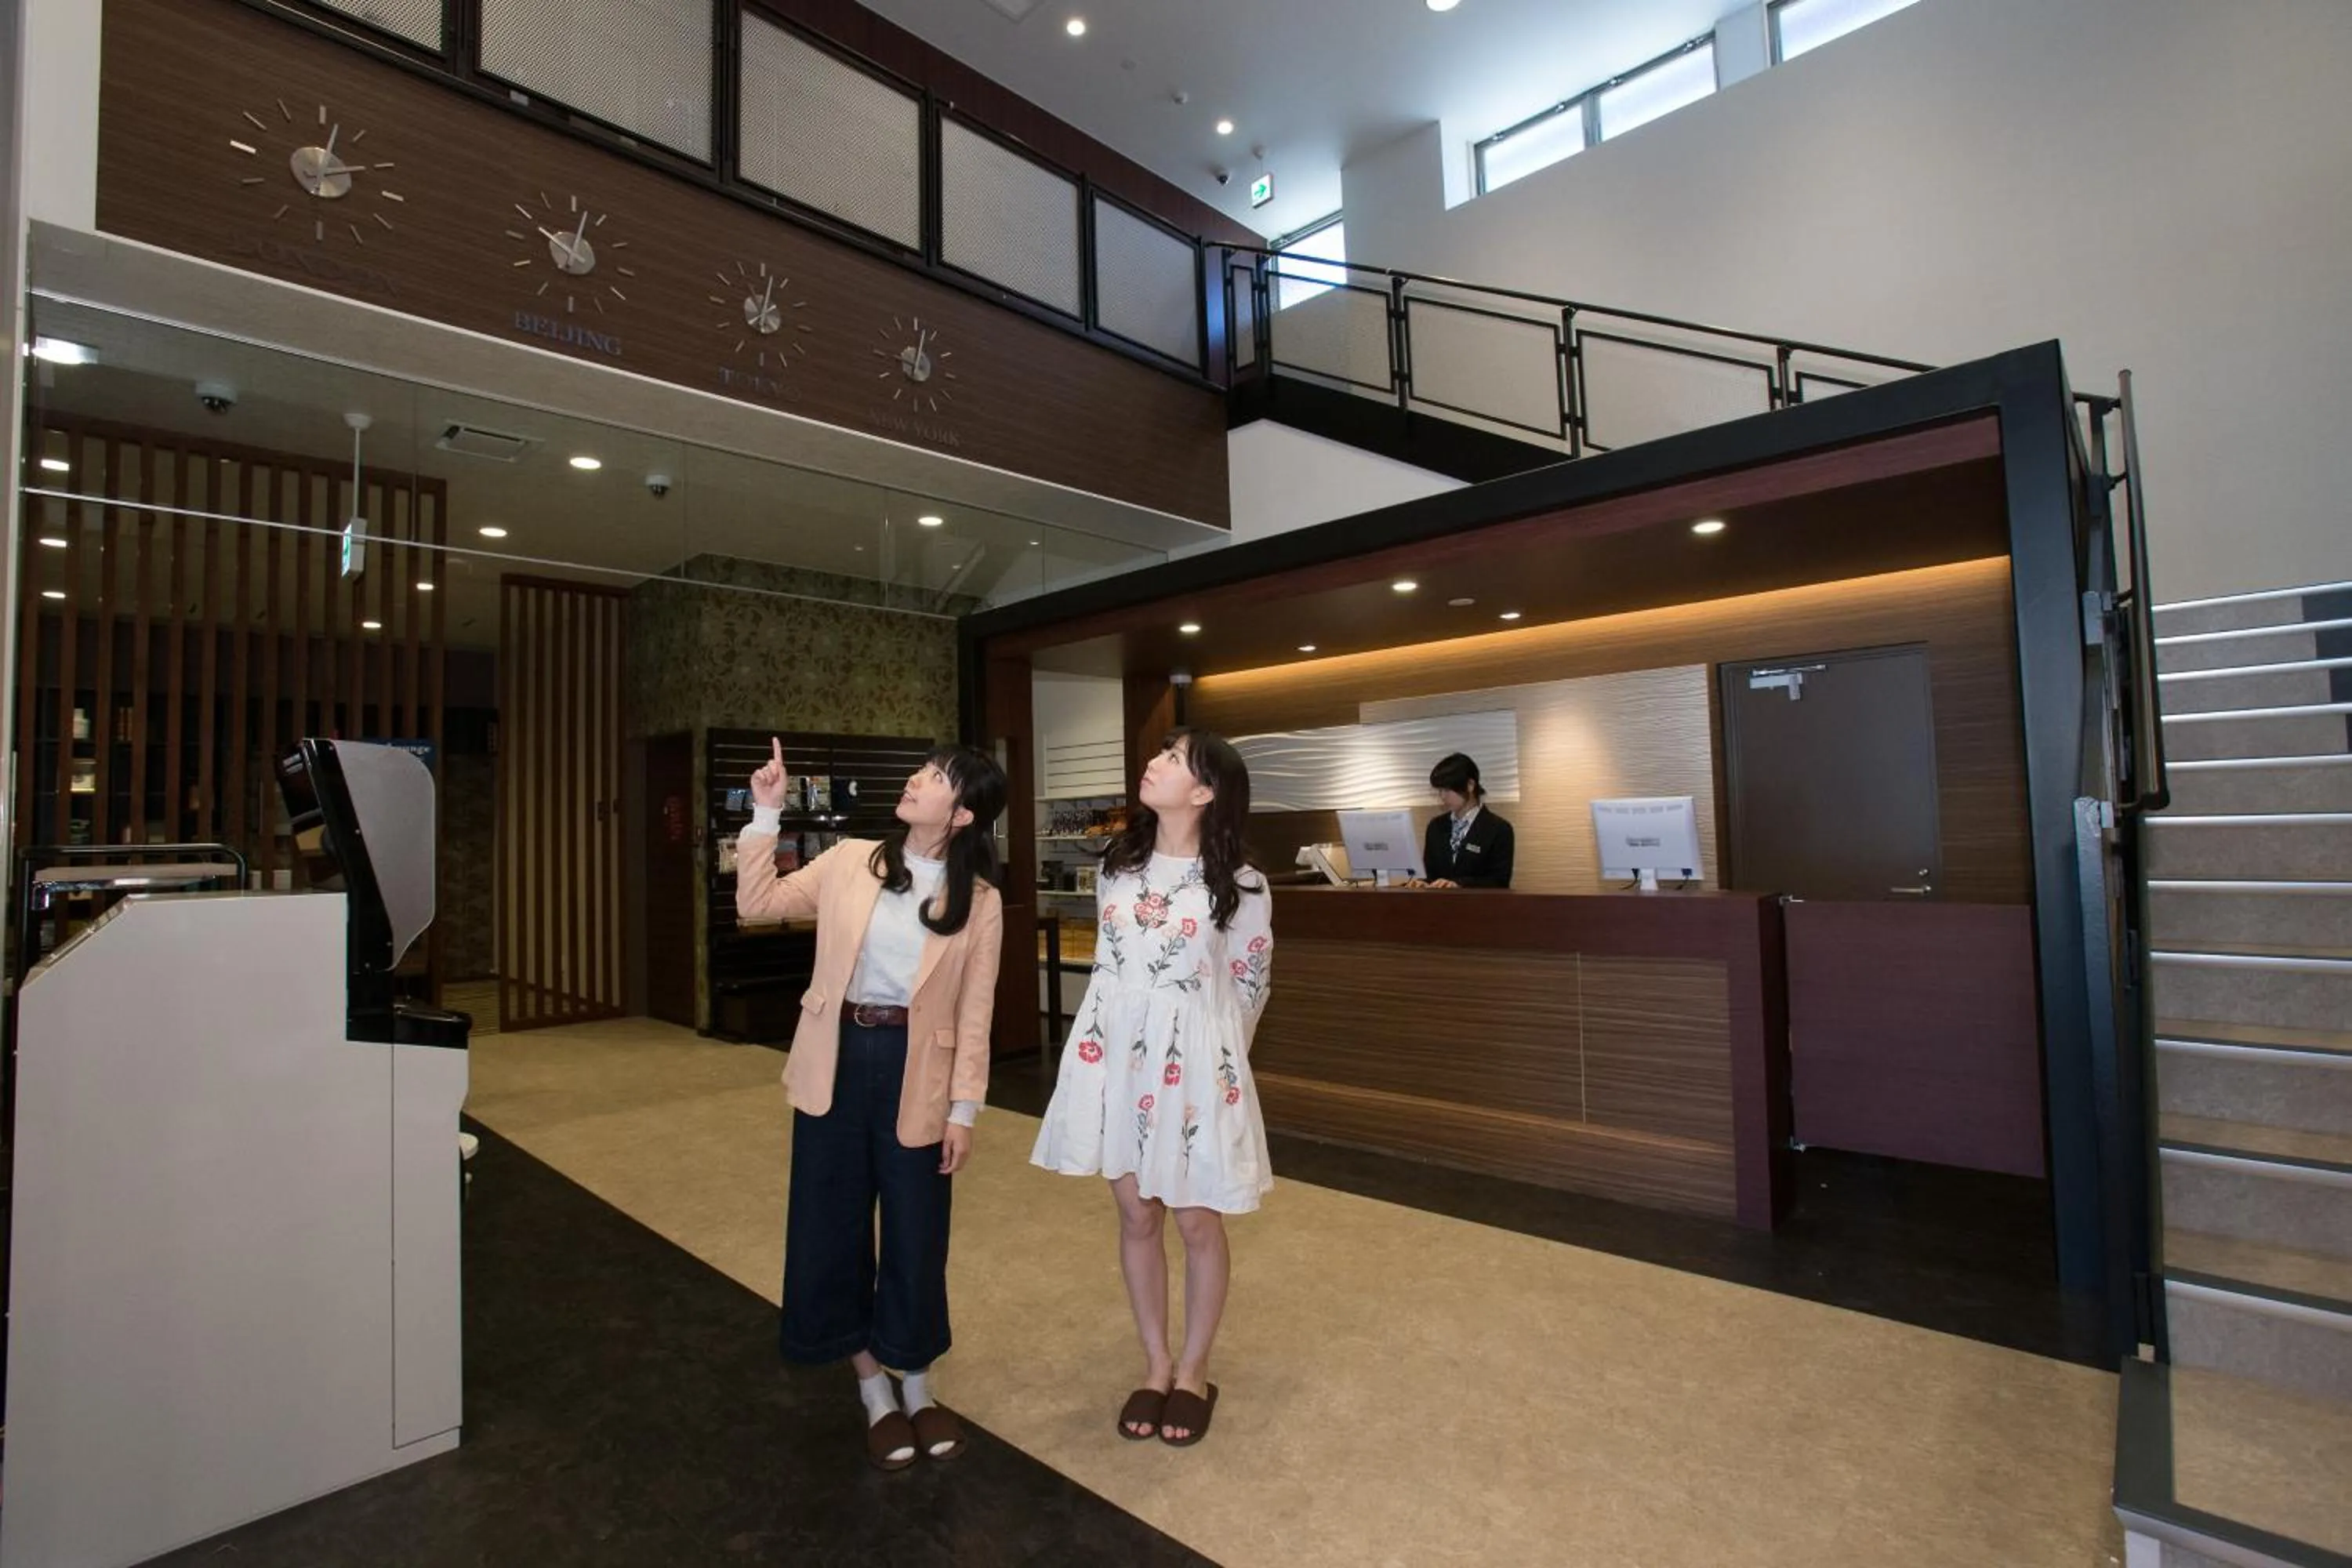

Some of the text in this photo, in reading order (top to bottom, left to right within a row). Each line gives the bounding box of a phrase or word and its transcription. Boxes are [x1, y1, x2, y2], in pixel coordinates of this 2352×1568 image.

[514, 310, 622, 356] BEIJING
[719, 366, 803, 402] TOKYO
[869, 406, 963, 447] NEW YORK
